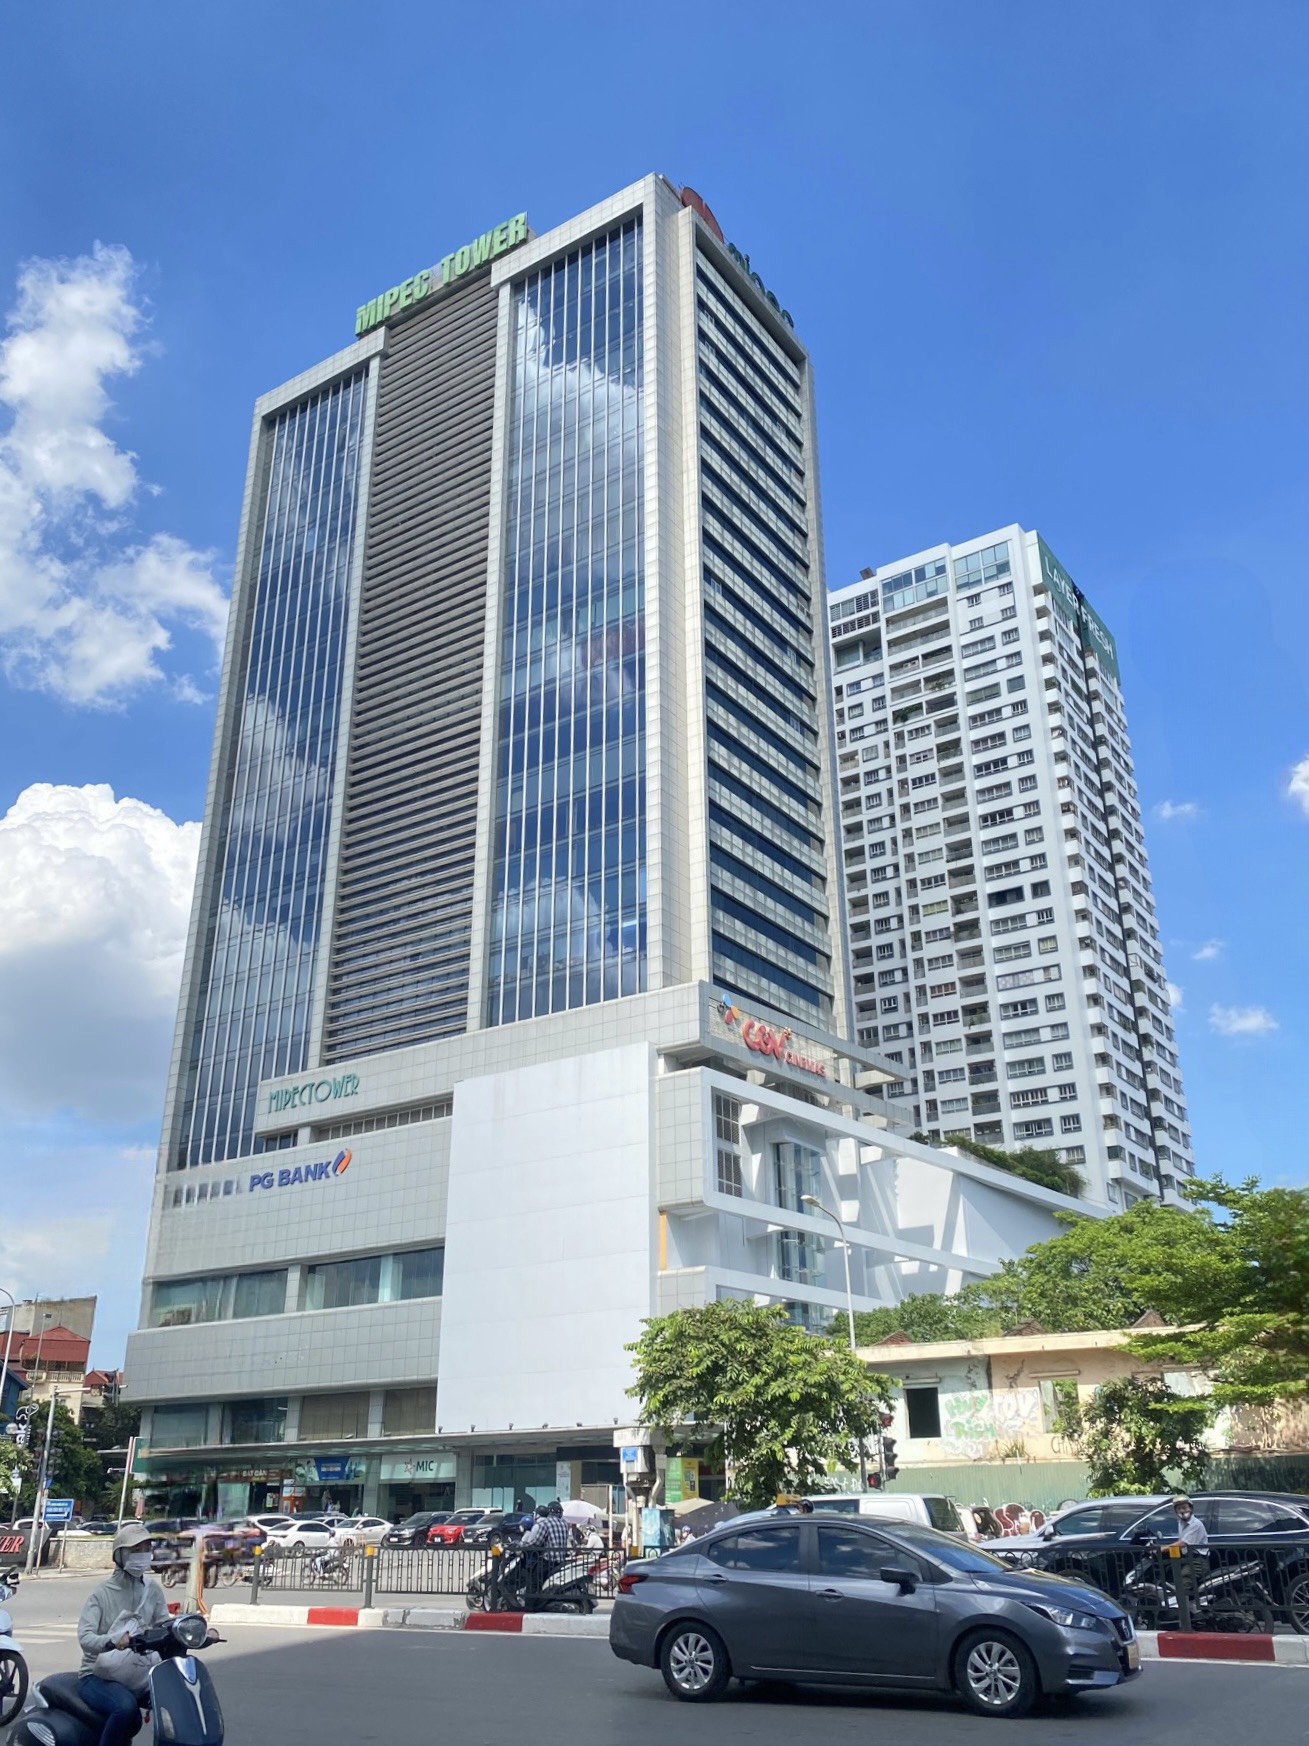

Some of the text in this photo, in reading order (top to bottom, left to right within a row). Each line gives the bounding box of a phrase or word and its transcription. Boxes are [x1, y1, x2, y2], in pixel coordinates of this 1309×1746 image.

[355, 212, 527, 335] MIPEC TOWER
[1045, 555, 1114, 660] LAYER FRESH
[250, 1160, 332, 1192] PG BANK
[416, 1460, 434, 1472] MIC
